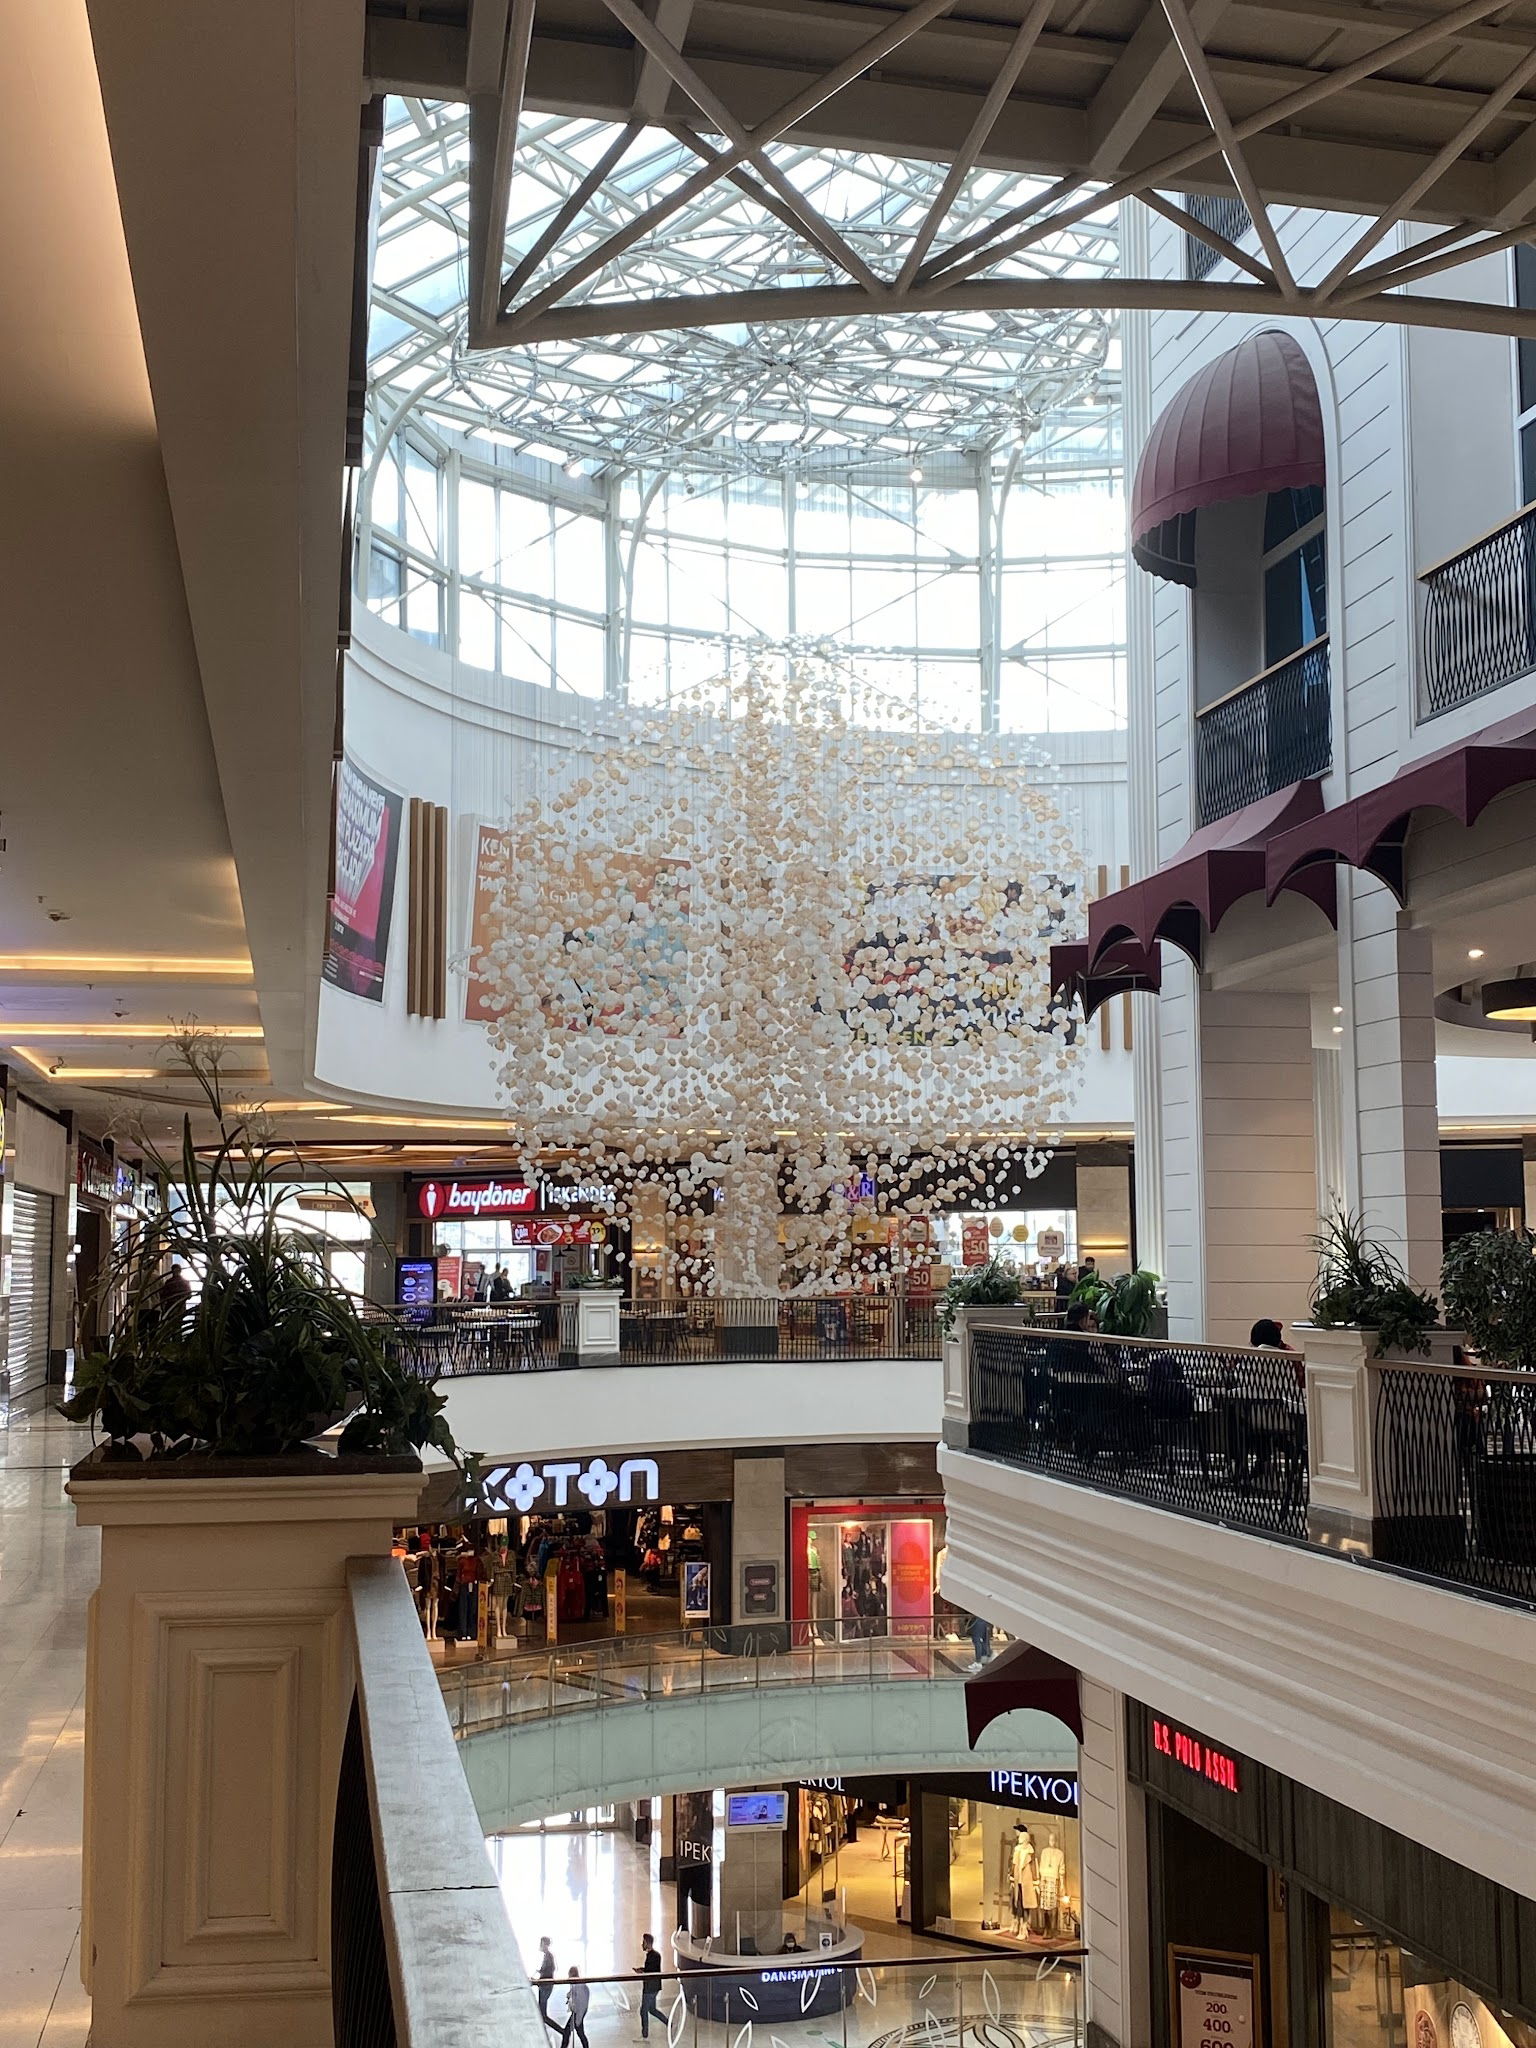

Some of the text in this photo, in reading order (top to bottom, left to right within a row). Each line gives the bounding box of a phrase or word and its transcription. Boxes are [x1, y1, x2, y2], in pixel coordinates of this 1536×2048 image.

[449, 1181, 531, 1215] baydöner
[1175, 1731, 1201, 1772] POLO
[680, 1840, 713, 1862] IPEK
[1206, 2002, 1227, 2015] 200
[1203, 2018, 1231, 2033] 400
